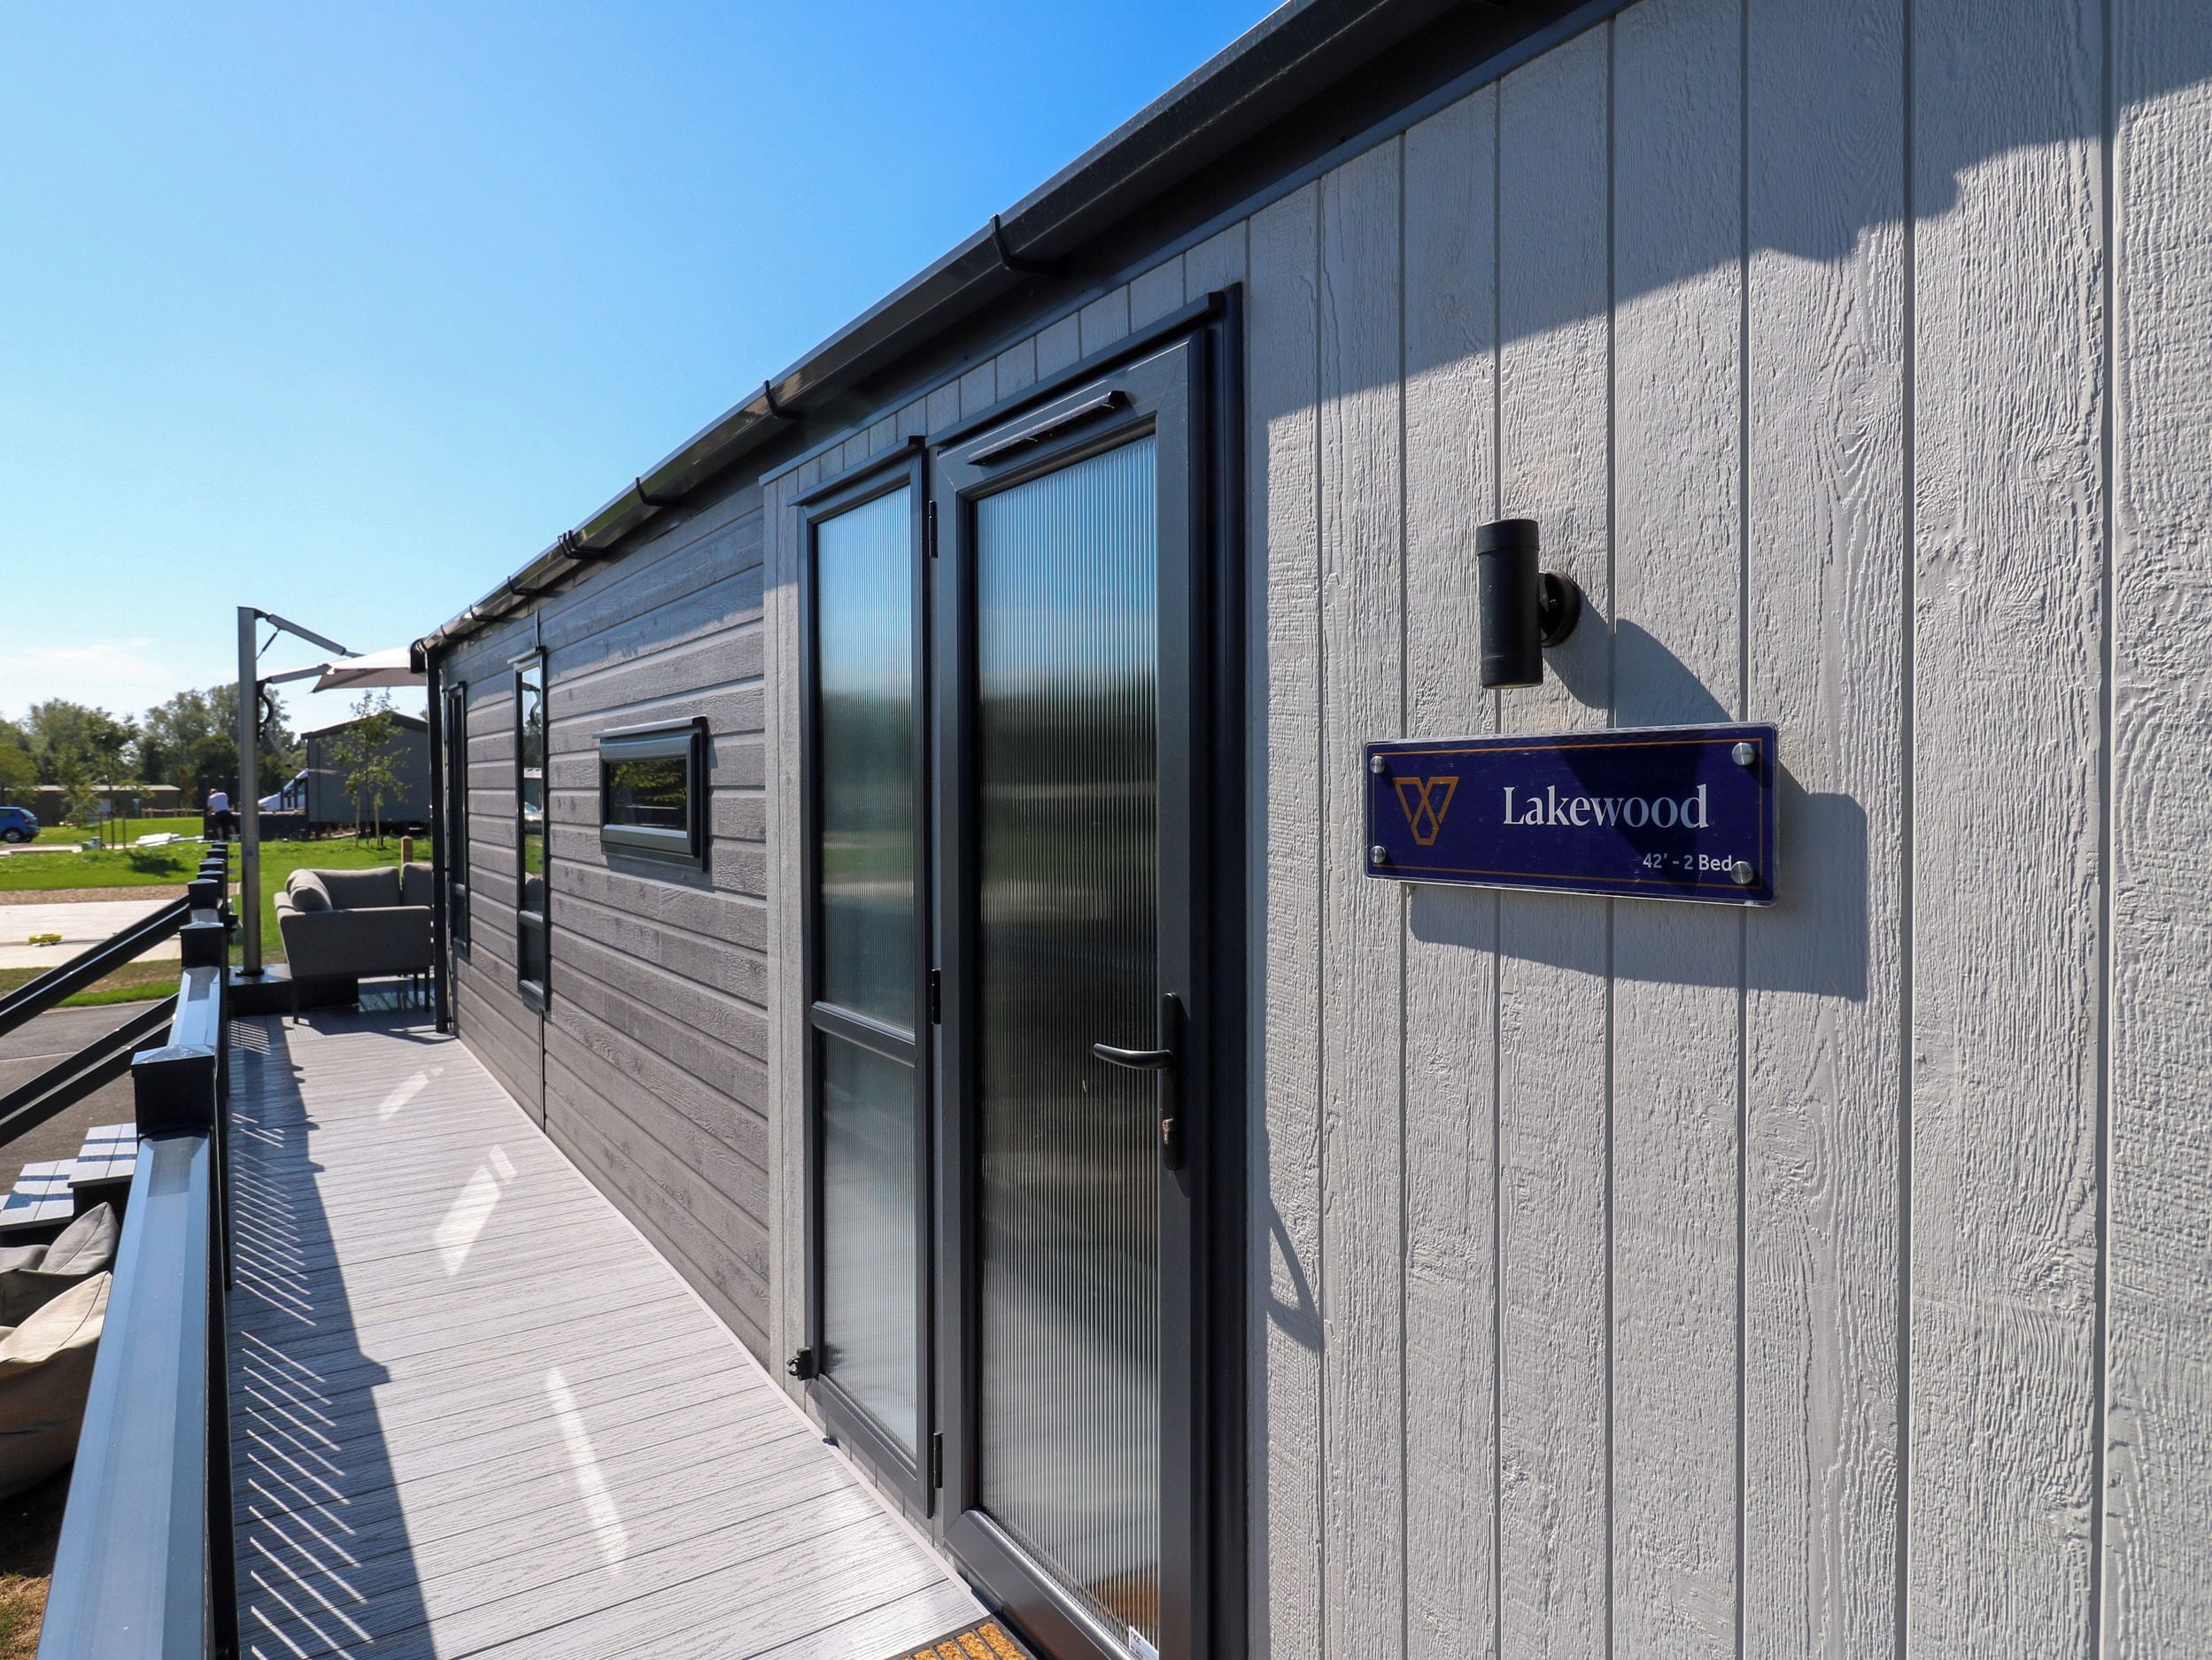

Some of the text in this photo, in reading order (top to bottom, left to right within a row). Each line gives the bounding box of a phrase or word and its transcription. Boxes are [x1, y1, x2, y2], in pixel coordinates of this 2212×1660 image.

[1503, 784, 1709, 829] Lakewood
[1643, 853, 1667, 869] 42'
[1683, 854, 1693, 870] 2
[1698, 853, 1732, 871] Bed
